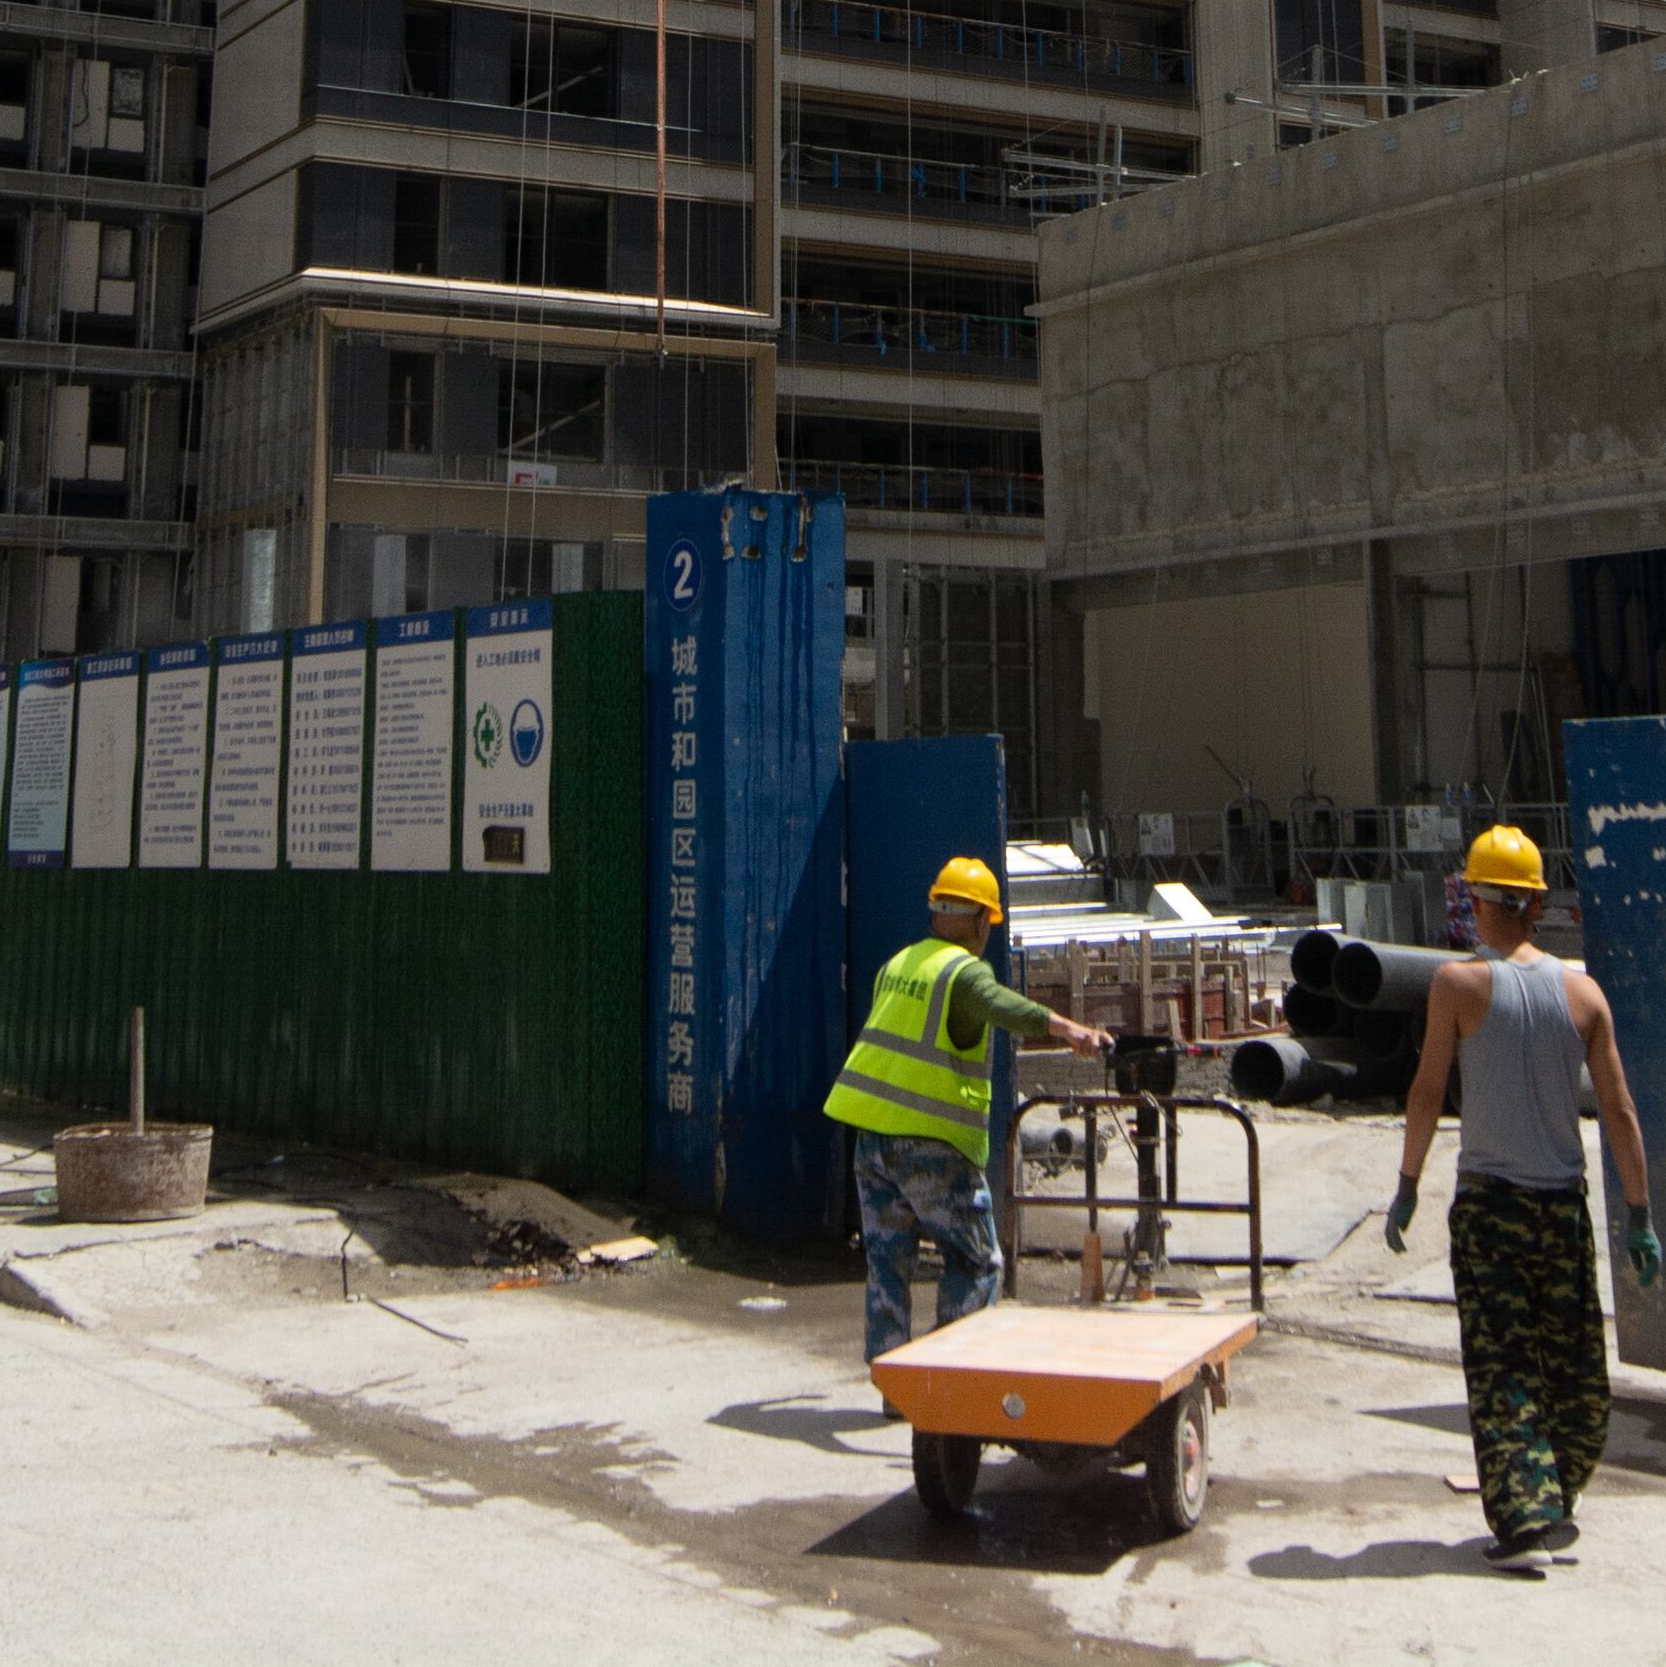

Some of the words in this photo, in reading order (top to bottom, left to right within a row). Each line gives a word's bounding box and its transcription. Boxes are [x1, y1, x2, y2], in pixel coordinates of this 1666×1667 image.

[672, 549, 693, 601] 2
[667, 635, 699, 1117] 城市和园区运营服务商
